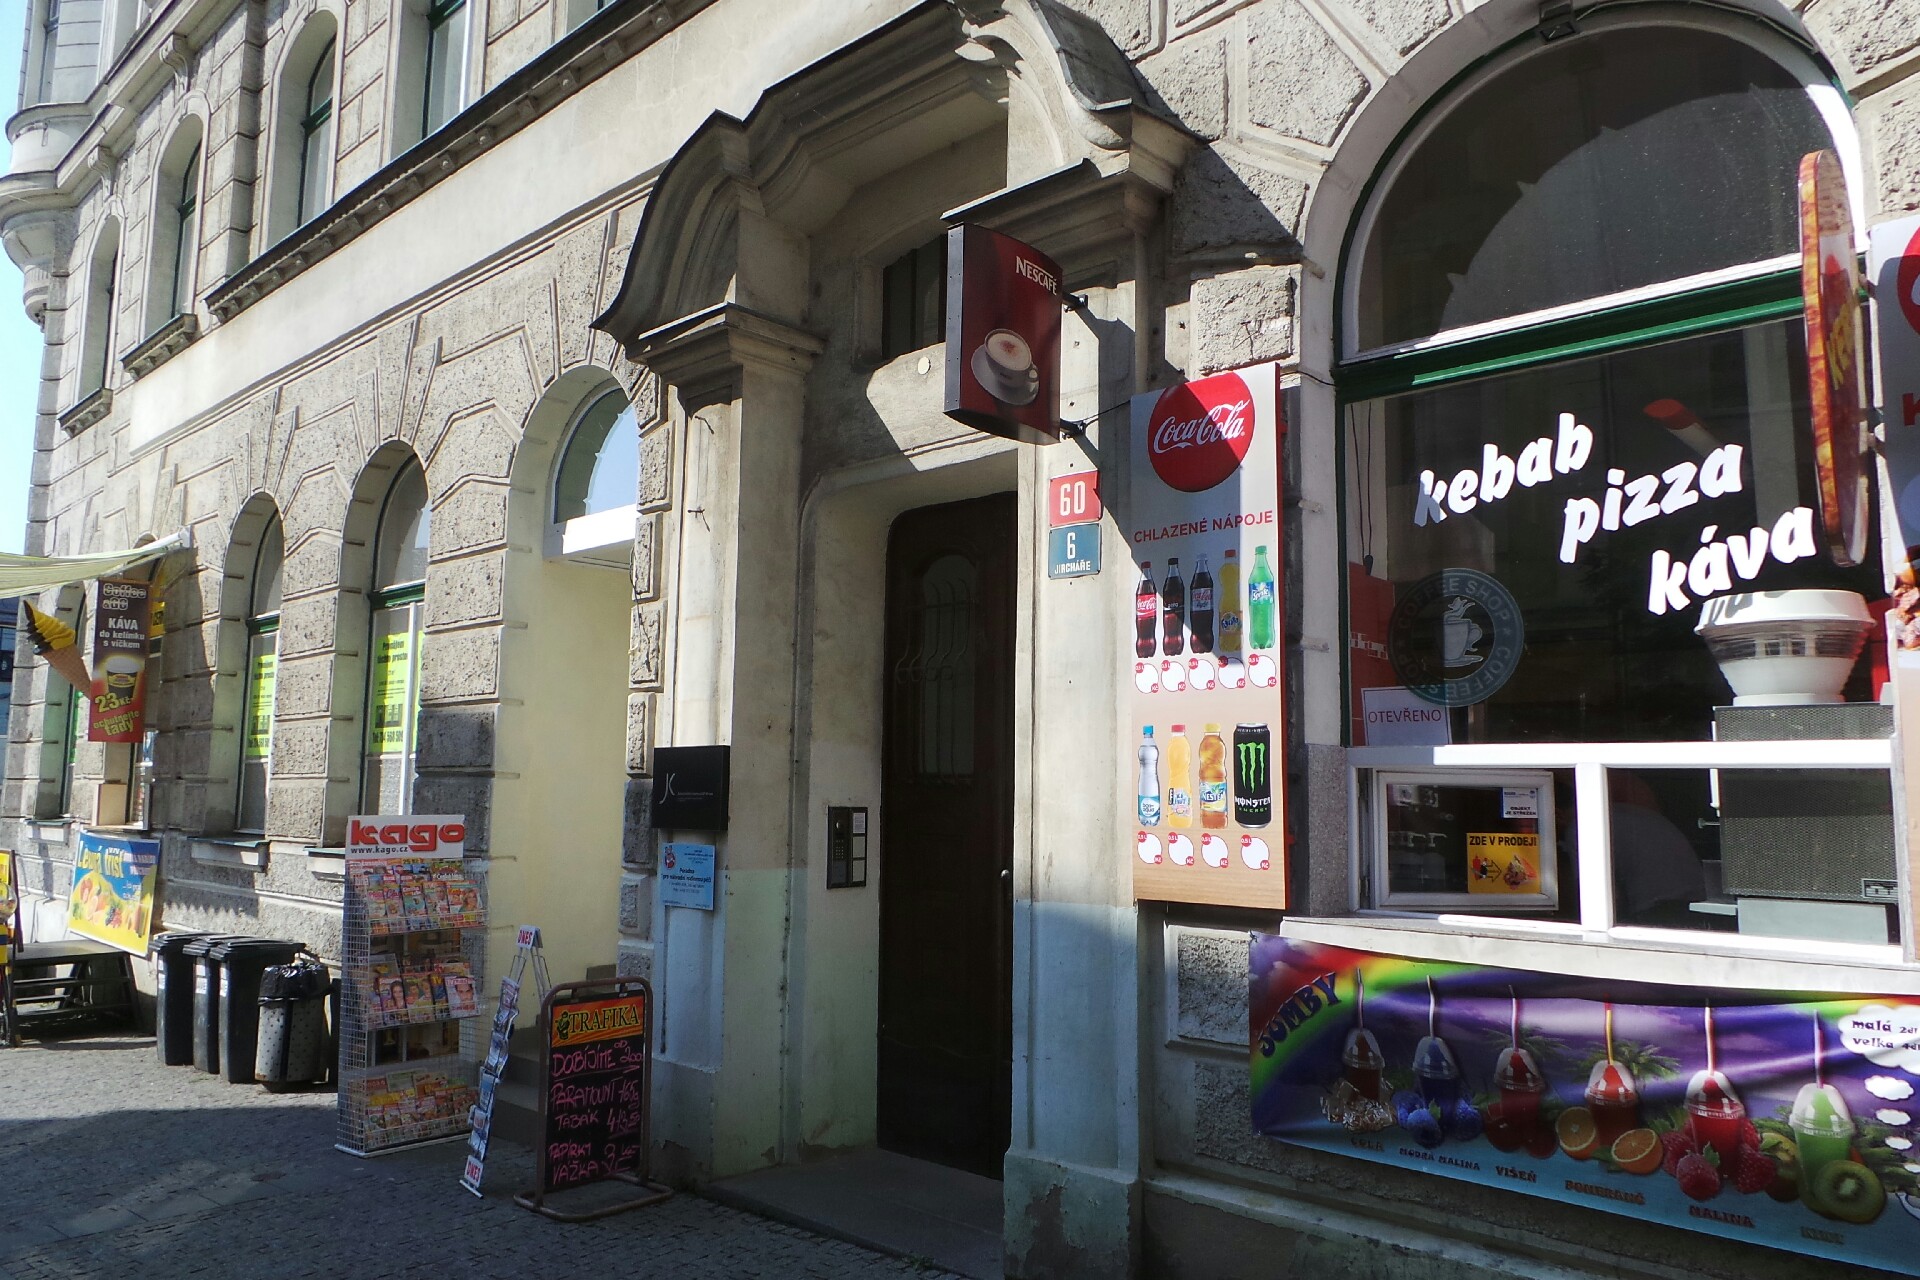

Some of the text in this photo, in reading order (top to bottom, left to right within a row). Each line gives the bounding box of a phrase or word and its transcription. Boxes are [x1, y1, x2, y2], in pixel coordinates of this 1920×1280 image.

[1016, 255, 1057, 295] NESCAFÉ
[1153, 399, 1250, 454] Coca-Cola
[1415, 412, 1594, 527] kebab
[1060, 480, 1086, 516] 60
[1559, 443, 1744, 563] pizza
[1134, 510, 1273, 543] CHLAZENÉ NÁPOJE
[1067, 532, 1076, 559] 6
[1054, 559, 1091, 575] JIRCHÁŘE
[1648, 506, 1817, 615] káva
[103, 583, 146, 599] Coffee
[108, 616, 139, 630] KÁVA
[100, 630, 145, 640] do kelímku
[95, 693, 120, 713] 23
[1368, 708, 1442, 723] OTEVŘENO
[104, 718, 134, 736] tady
[350, 820, 465, 852] kago
[1470, 836, 1537, 847] ZDE V PRODEJI
[350, 845, 409, 855] www.kago.cz
[518, 928, 533, 946] DNES
[569, 1004, 639, 1033] TRAFIKA
[1852, 1020, 1892, 1032] malá
[551, 1044, 616, 1077] DOBÍJÍME
[550, 1077, 623, 1111] PARAMOUNT
[554, 1109, 599, 1132] TABÁK
[467, 1164, 481, 1184] DNES
[1438, 1156, 1481, 1171] MALINA
[1688, 1206, 1755, 1228] MALINA
